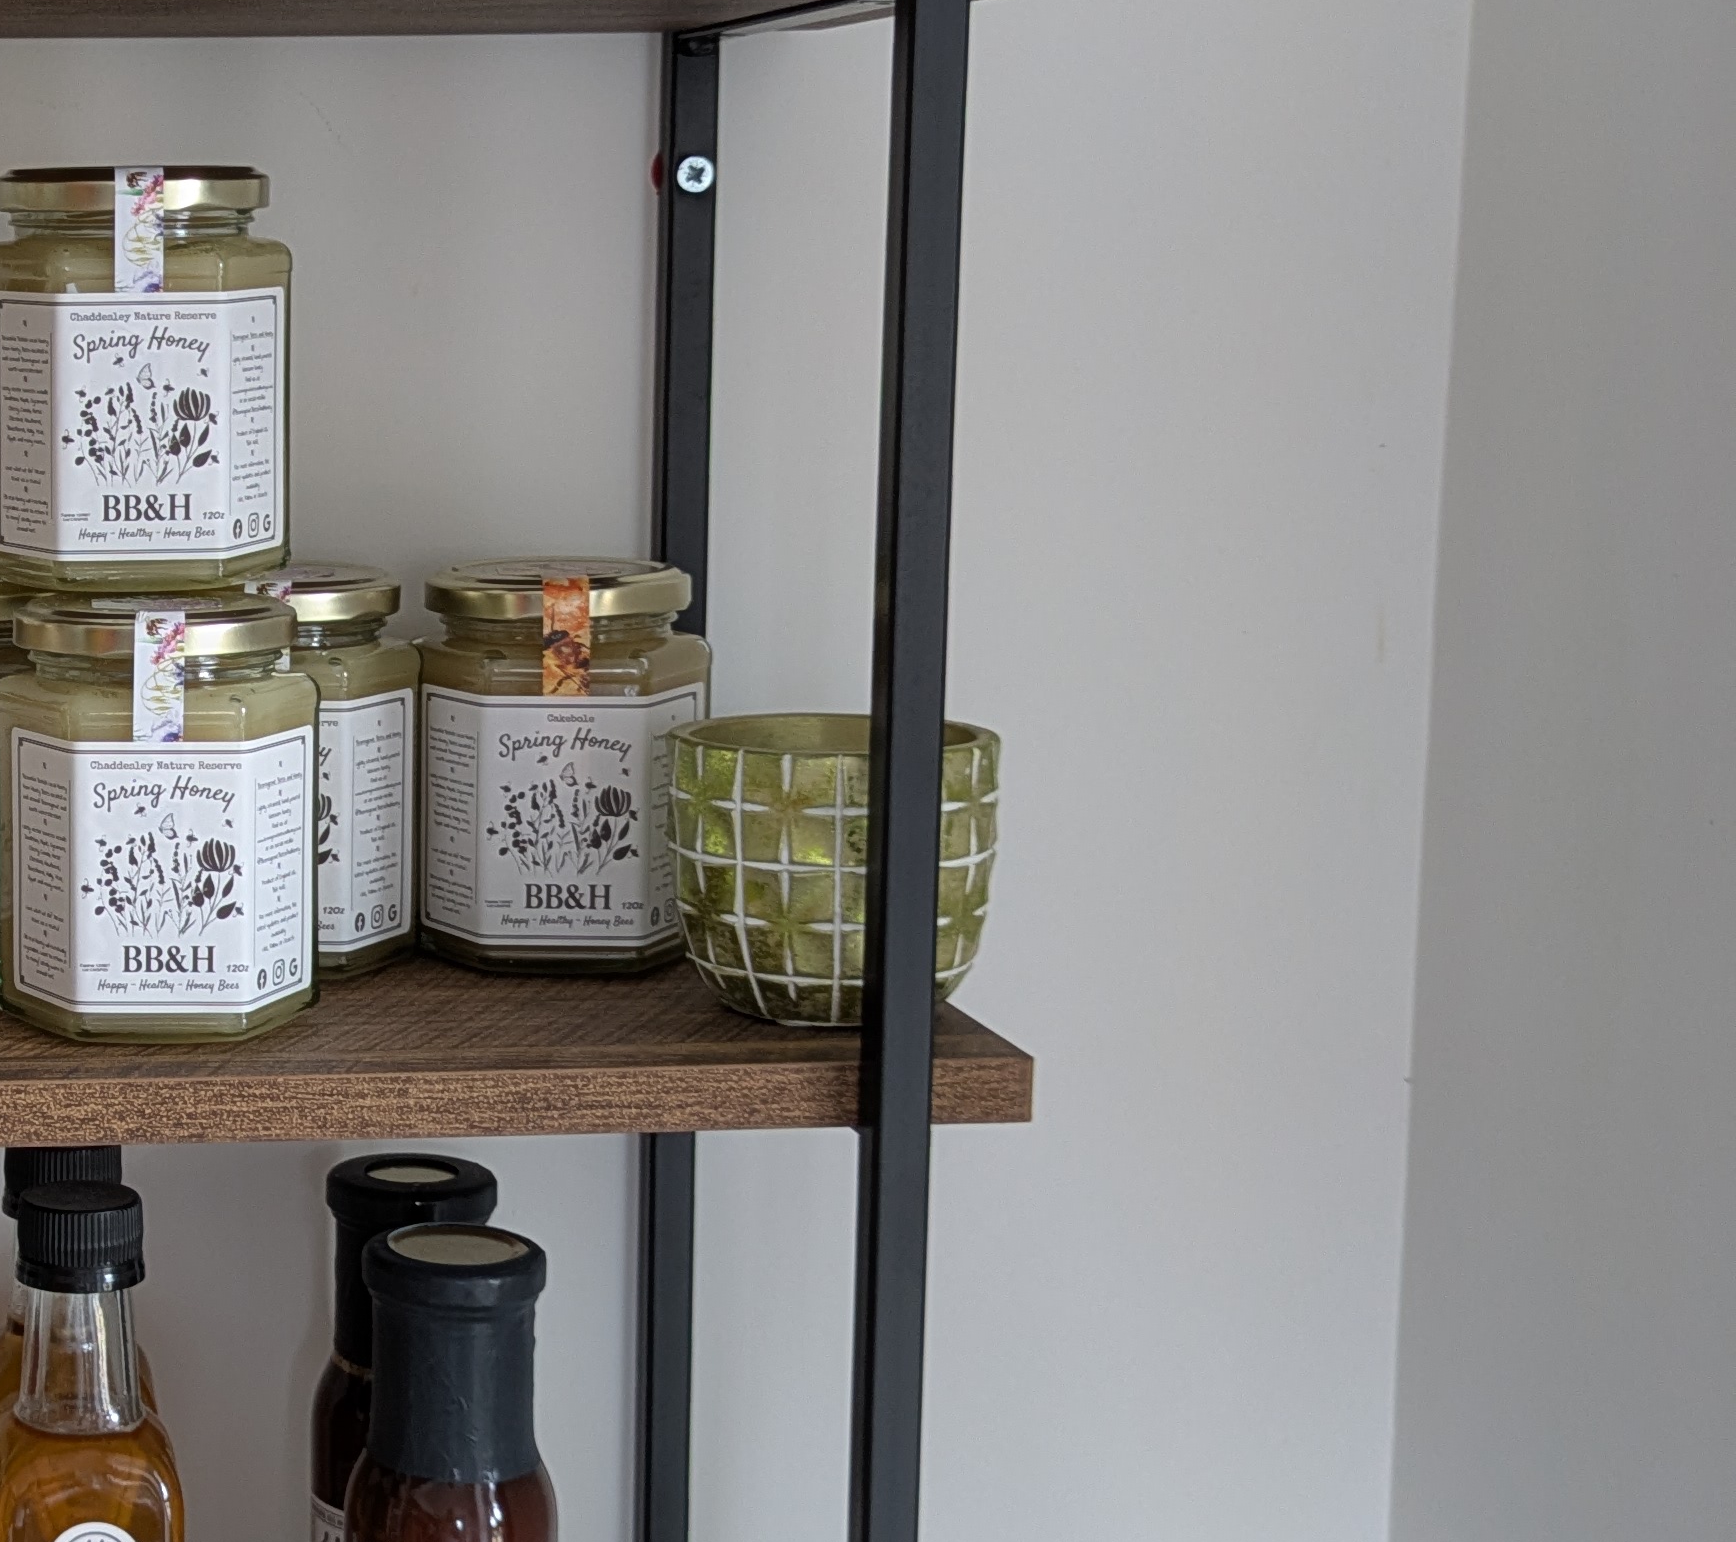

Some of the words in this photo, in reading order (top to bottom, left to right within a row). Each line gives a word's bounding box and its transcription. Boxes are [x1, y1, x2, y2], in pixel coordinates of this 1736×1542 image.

[69, 312, 132, 324] Chaddesley
[133, 311, 172, 321] Nature
[174, 311, 217, 321] Reserve
[72, 329, 144, 364] Spring
[146, 325, 210, 363] Honey
[101, 493, 193, 522] BB&H
[78, 527, 108, 542] Happy
[118, 527, 153, 542] Healthy
[163, 526, 191, 541] Honey
[194, 527, 216, 538] Bees
[547, 714, 595, 723] Cakebole
[498, 730, 568, 761] Spring
[569, 727, 632, 763] Honey
[90, 761, 154, 772] Chaddesley
[156, 761, 196, 770] Nature
[198, 761, 243, 770] Reserve
[93, 778, 167, 813] Spring
[169, 774, 235, 813] Honey
[524, 883, 613, 911] BB&H
[501, 914, 531, 927] Happy
[539, 914, 574, 928] Healthy
[583, 915, 611, 928] Honey
[612, 915, 635, 927] Bees
[122, 945, 217, 974] BB&H
[97, 978, 129, 994] Happy
[138, 978, 175, 993] Healthy
[185, 978, 215, 994] Honey
[217, 979, 240, 991] Bees
